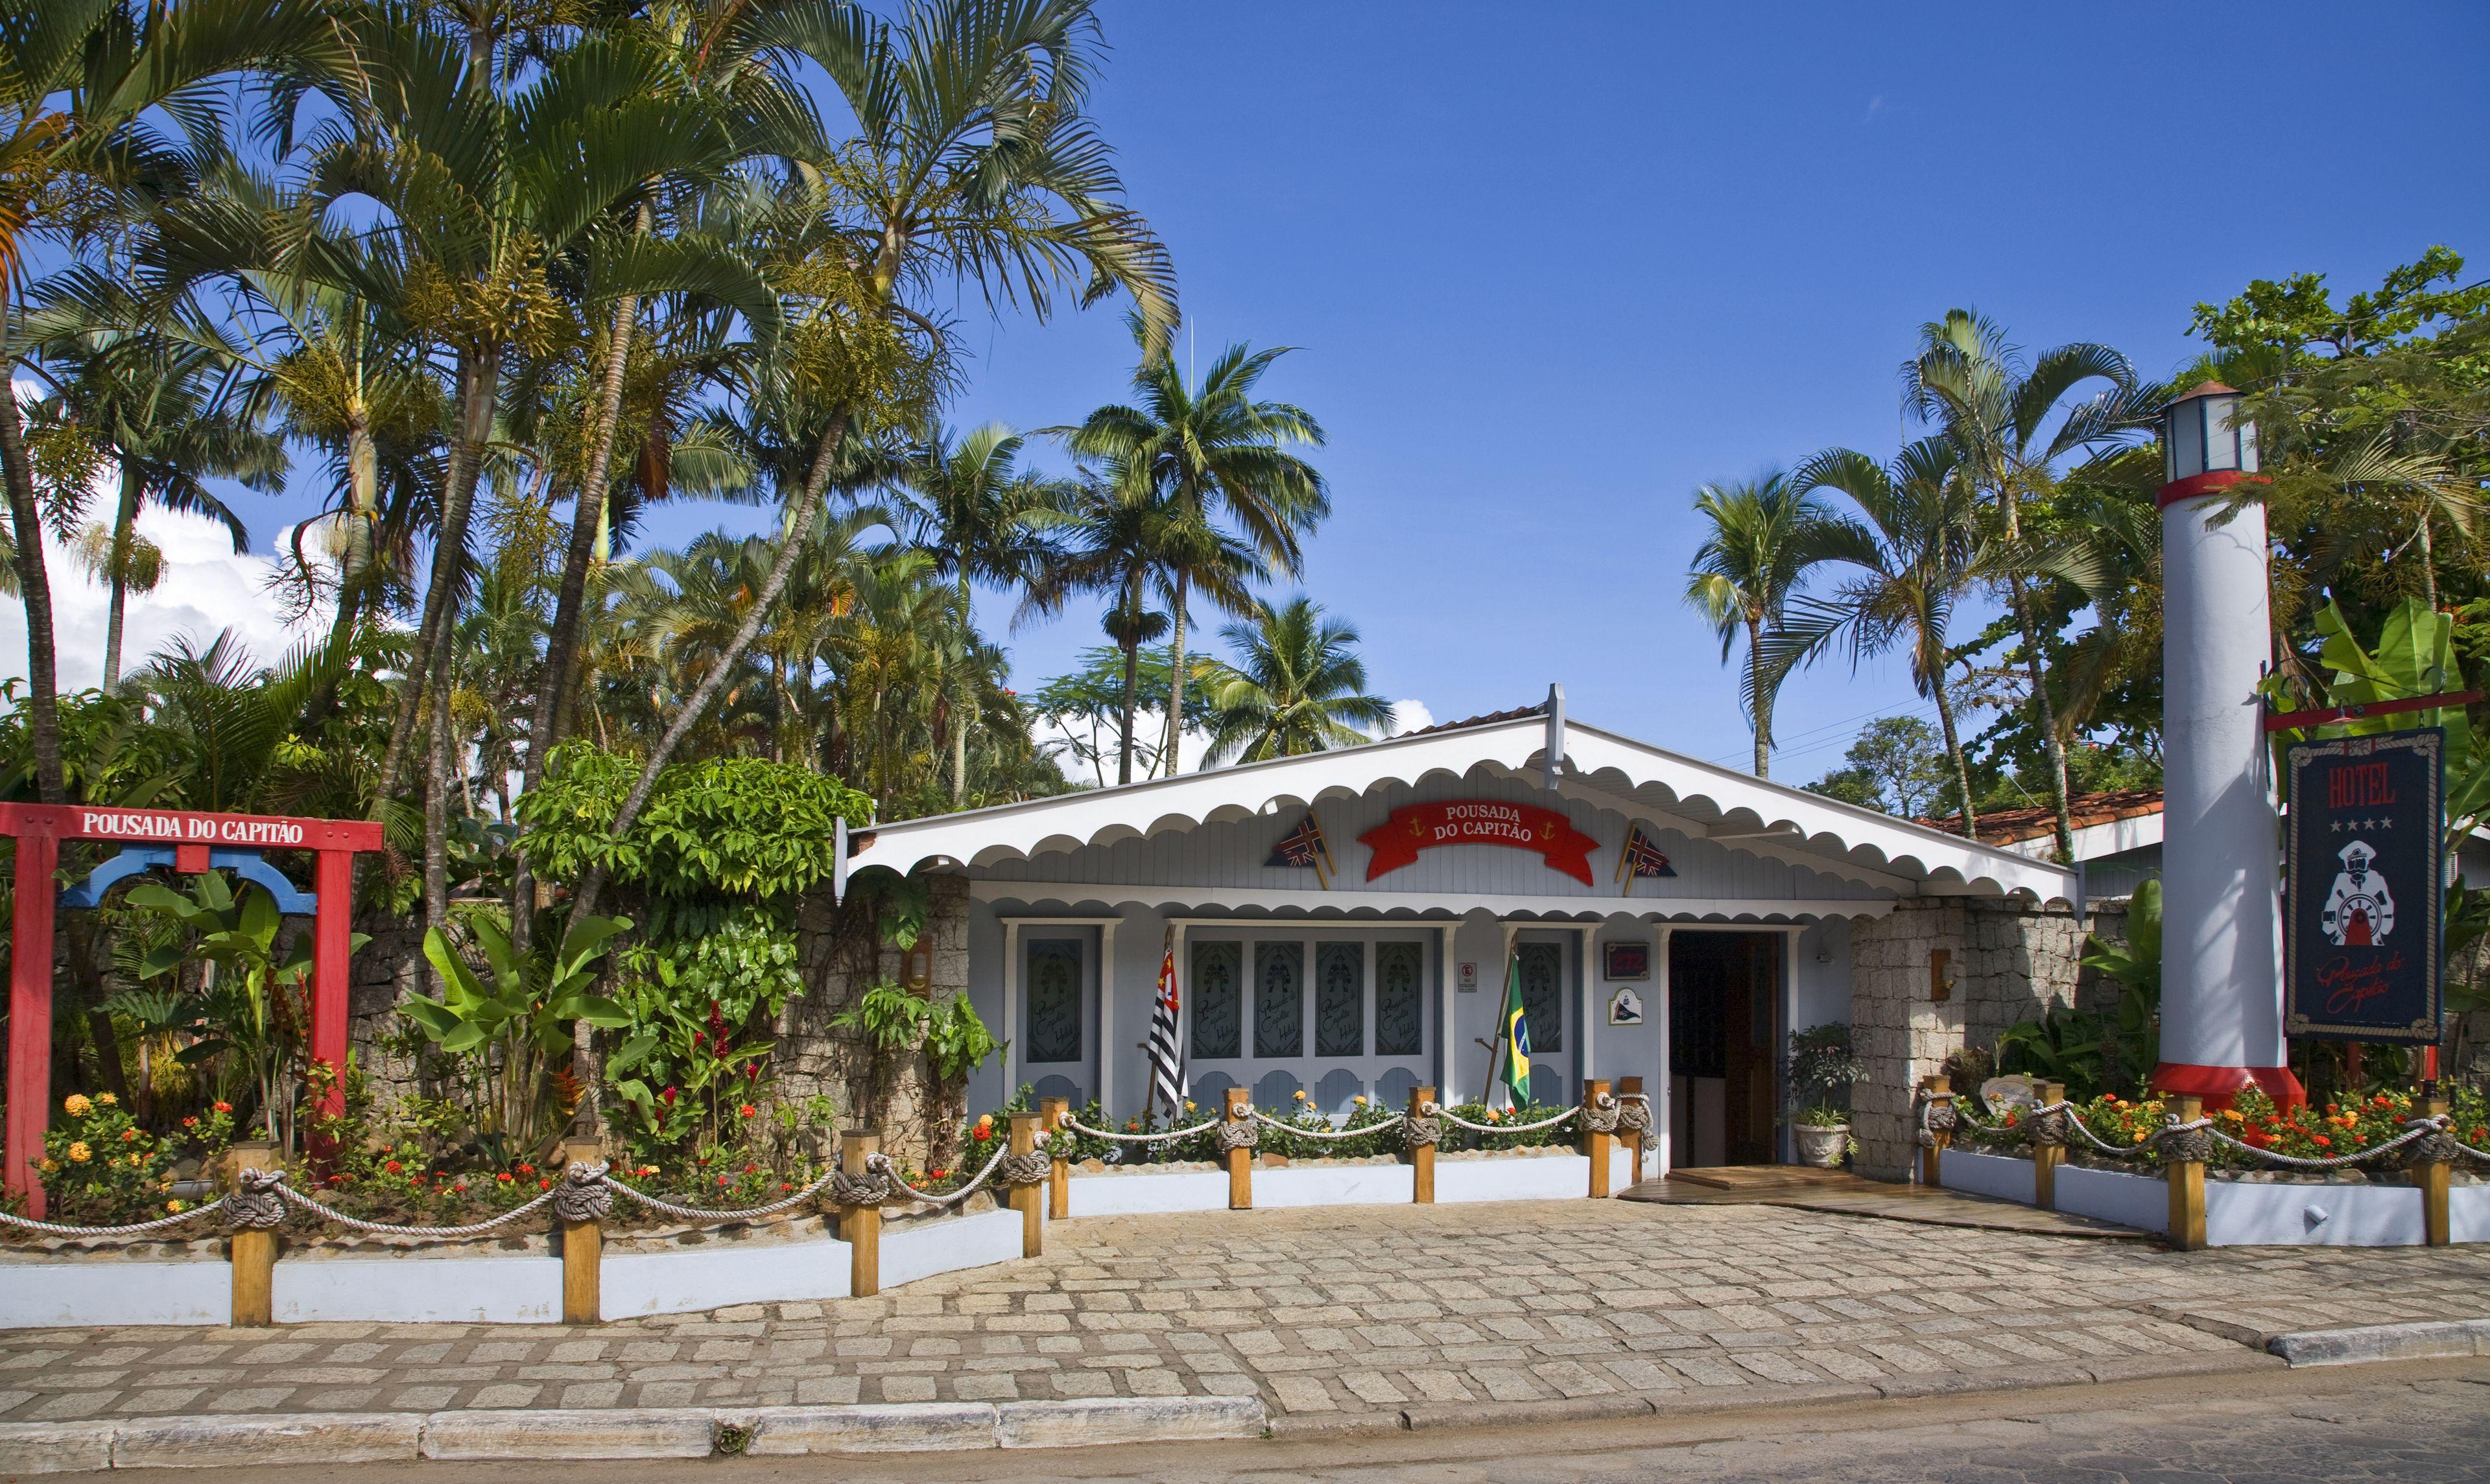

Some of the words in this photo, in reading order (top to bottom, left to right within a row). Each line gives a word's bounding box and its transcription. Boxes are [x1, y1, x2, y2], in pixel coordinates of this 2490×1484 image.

[2329, 762, 2396, 809] HOTEL
[1446, 805, 1521, 822] POUSADA
[82, 812, 182, 838] POUSADA
[188, 818, 217, 839] DO
[222, 820, 303, 844] CAPITÃO
[1434, 824, 1458, 840] DO
[1463, 821, 1532, 842] CAPITÃO
[1611, 954, 1644, 971] 272
